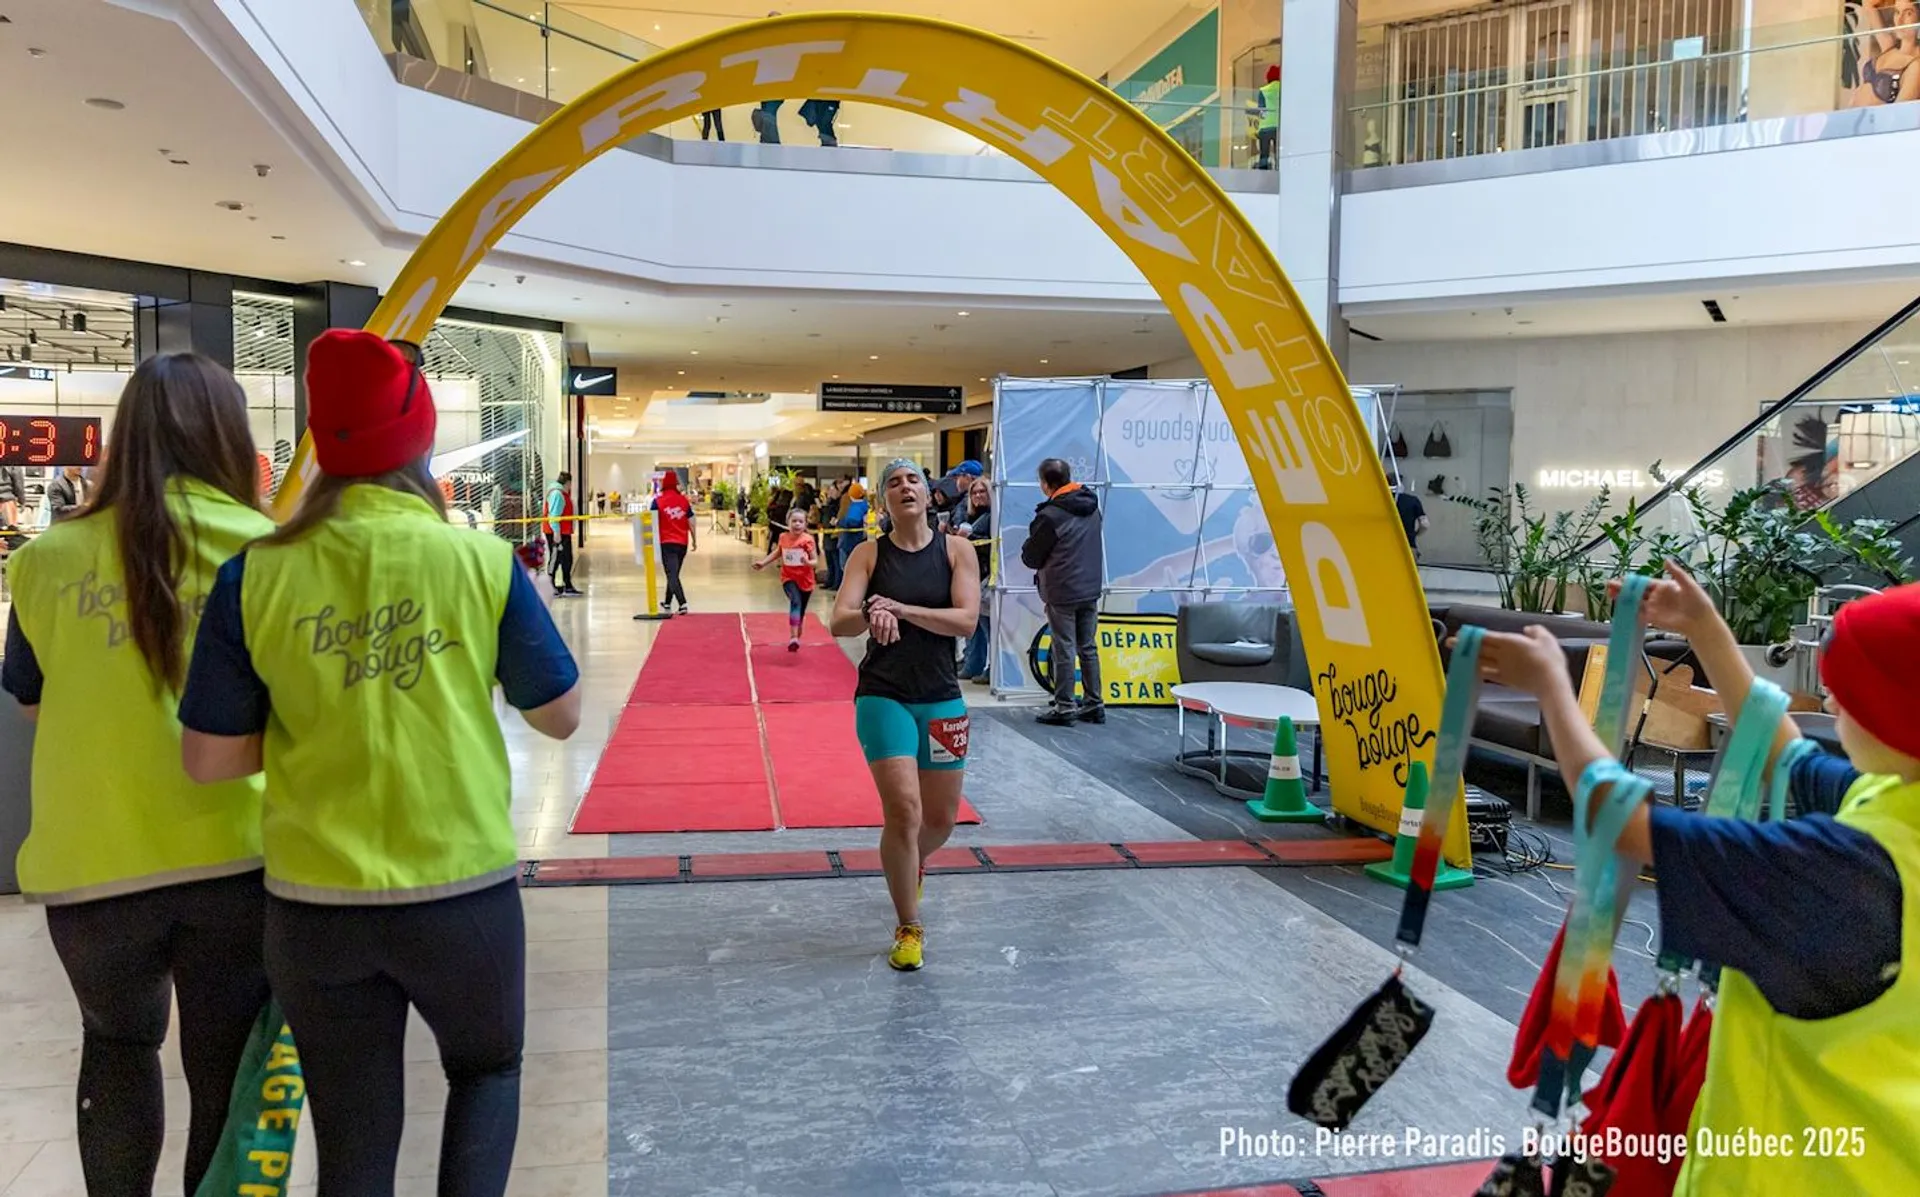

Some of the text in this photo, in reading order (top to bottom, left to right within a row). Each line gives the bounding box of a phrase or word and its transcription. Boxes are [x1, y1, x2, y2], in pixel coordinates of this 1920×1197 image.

[1539, 469, 1645, 487] MICHAEL
[294, 598, 426, 656] bouge
[1101, 628, 1173, 648] DÉPART
[328, 629, 465, 691] bouge
[1318, 662, 1397, 730] bouge
[1344, 713, 1437, 788] bouge
